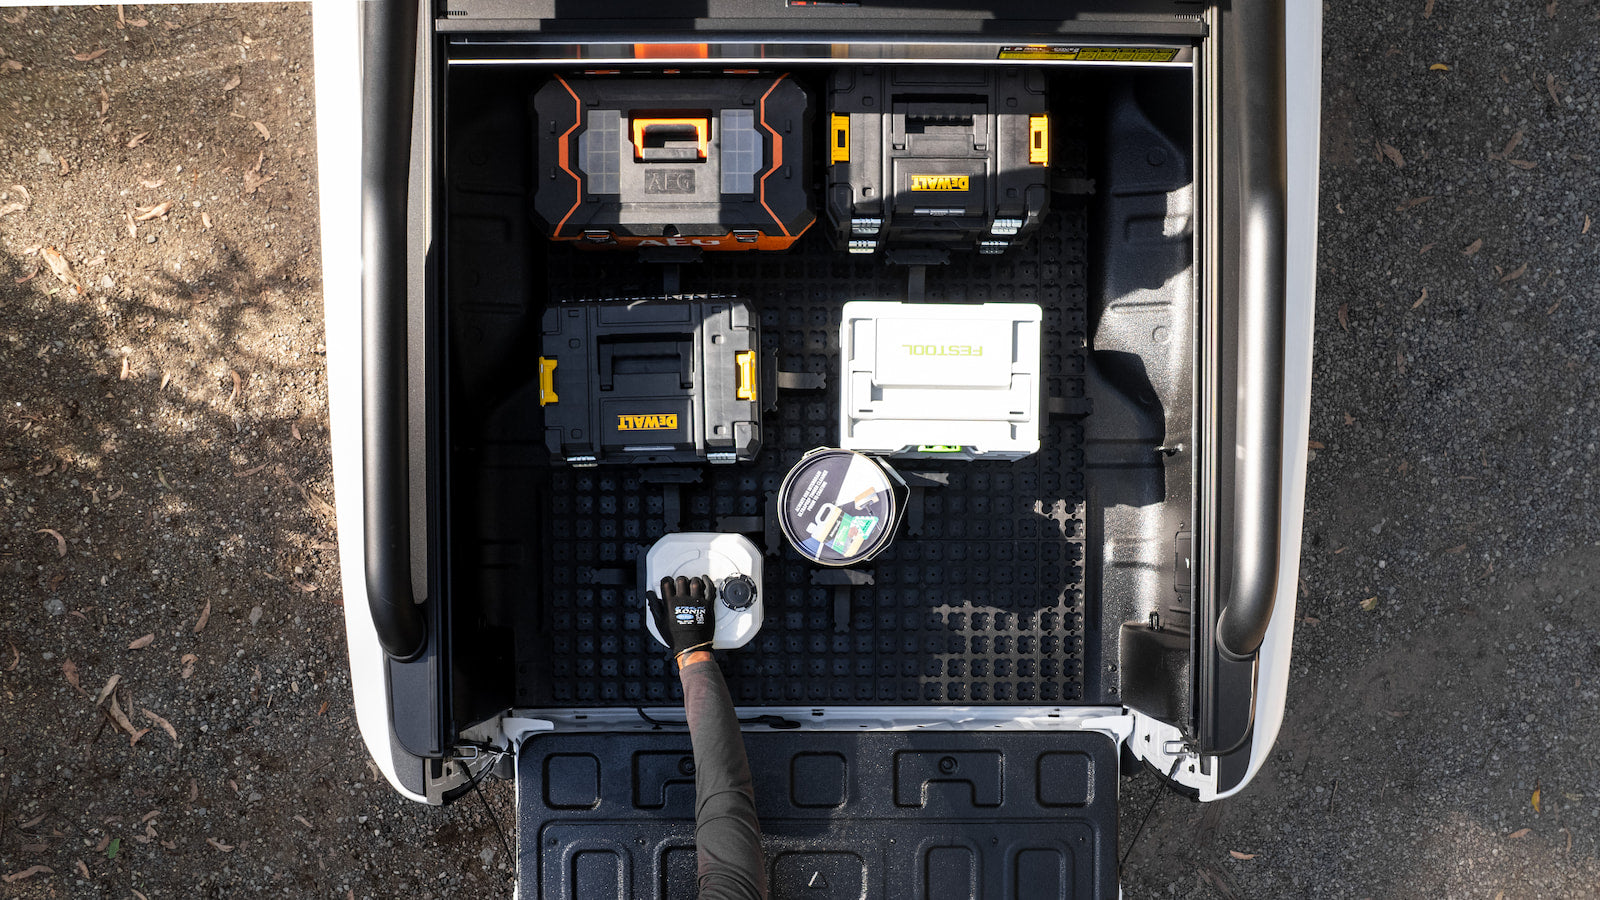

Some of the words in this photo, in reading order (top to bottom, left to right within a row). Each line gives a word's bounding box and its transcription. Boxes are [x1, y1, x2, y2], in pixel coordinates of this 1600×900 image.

[648, 173, 690, 190] AEG
[911, 175, 969, 191] DEWALT
[638, 238, 720, 246] AEG
[901, 344, 983, 356] FESTOOL
[619, 414, 677, 430] DEWALT
